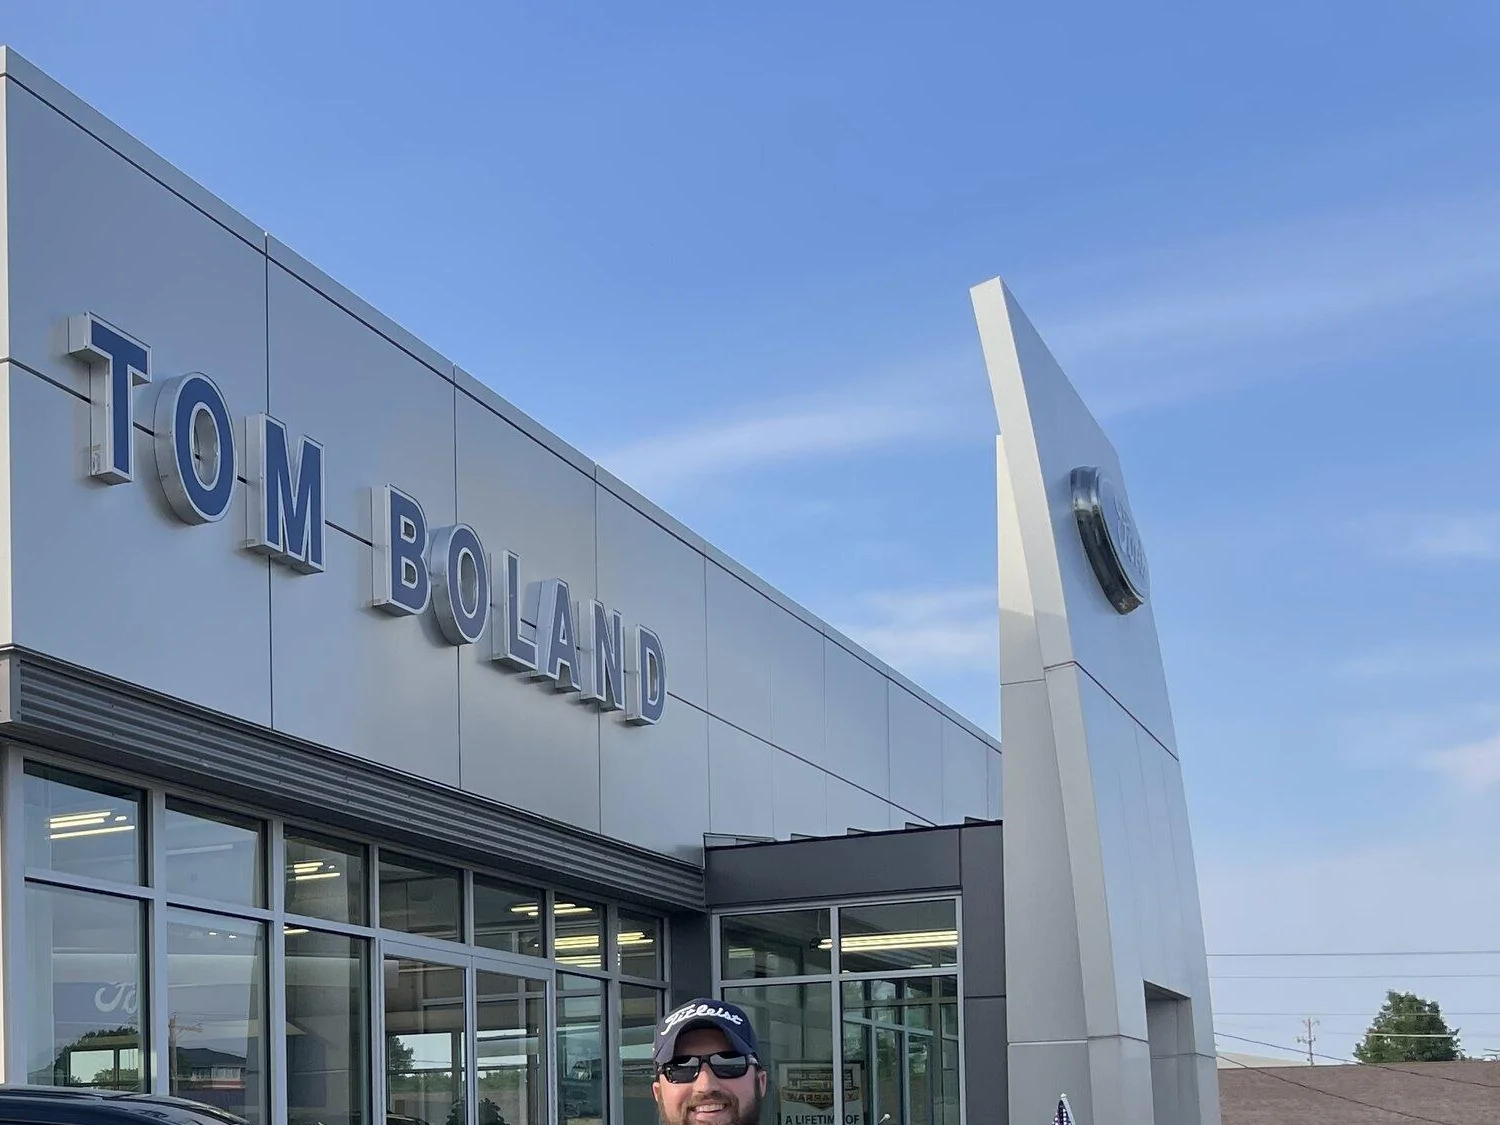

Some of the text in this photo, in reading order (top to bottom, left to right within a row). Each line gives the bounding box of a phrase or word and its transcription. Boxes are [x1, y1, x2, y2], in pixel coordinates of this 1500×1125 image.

[67, 311, 668, 726] TOM BOLAND
[660, 1004, 743, 1036] Titleist
[785, 1115, 860, 1125] A LIFETIM OF
